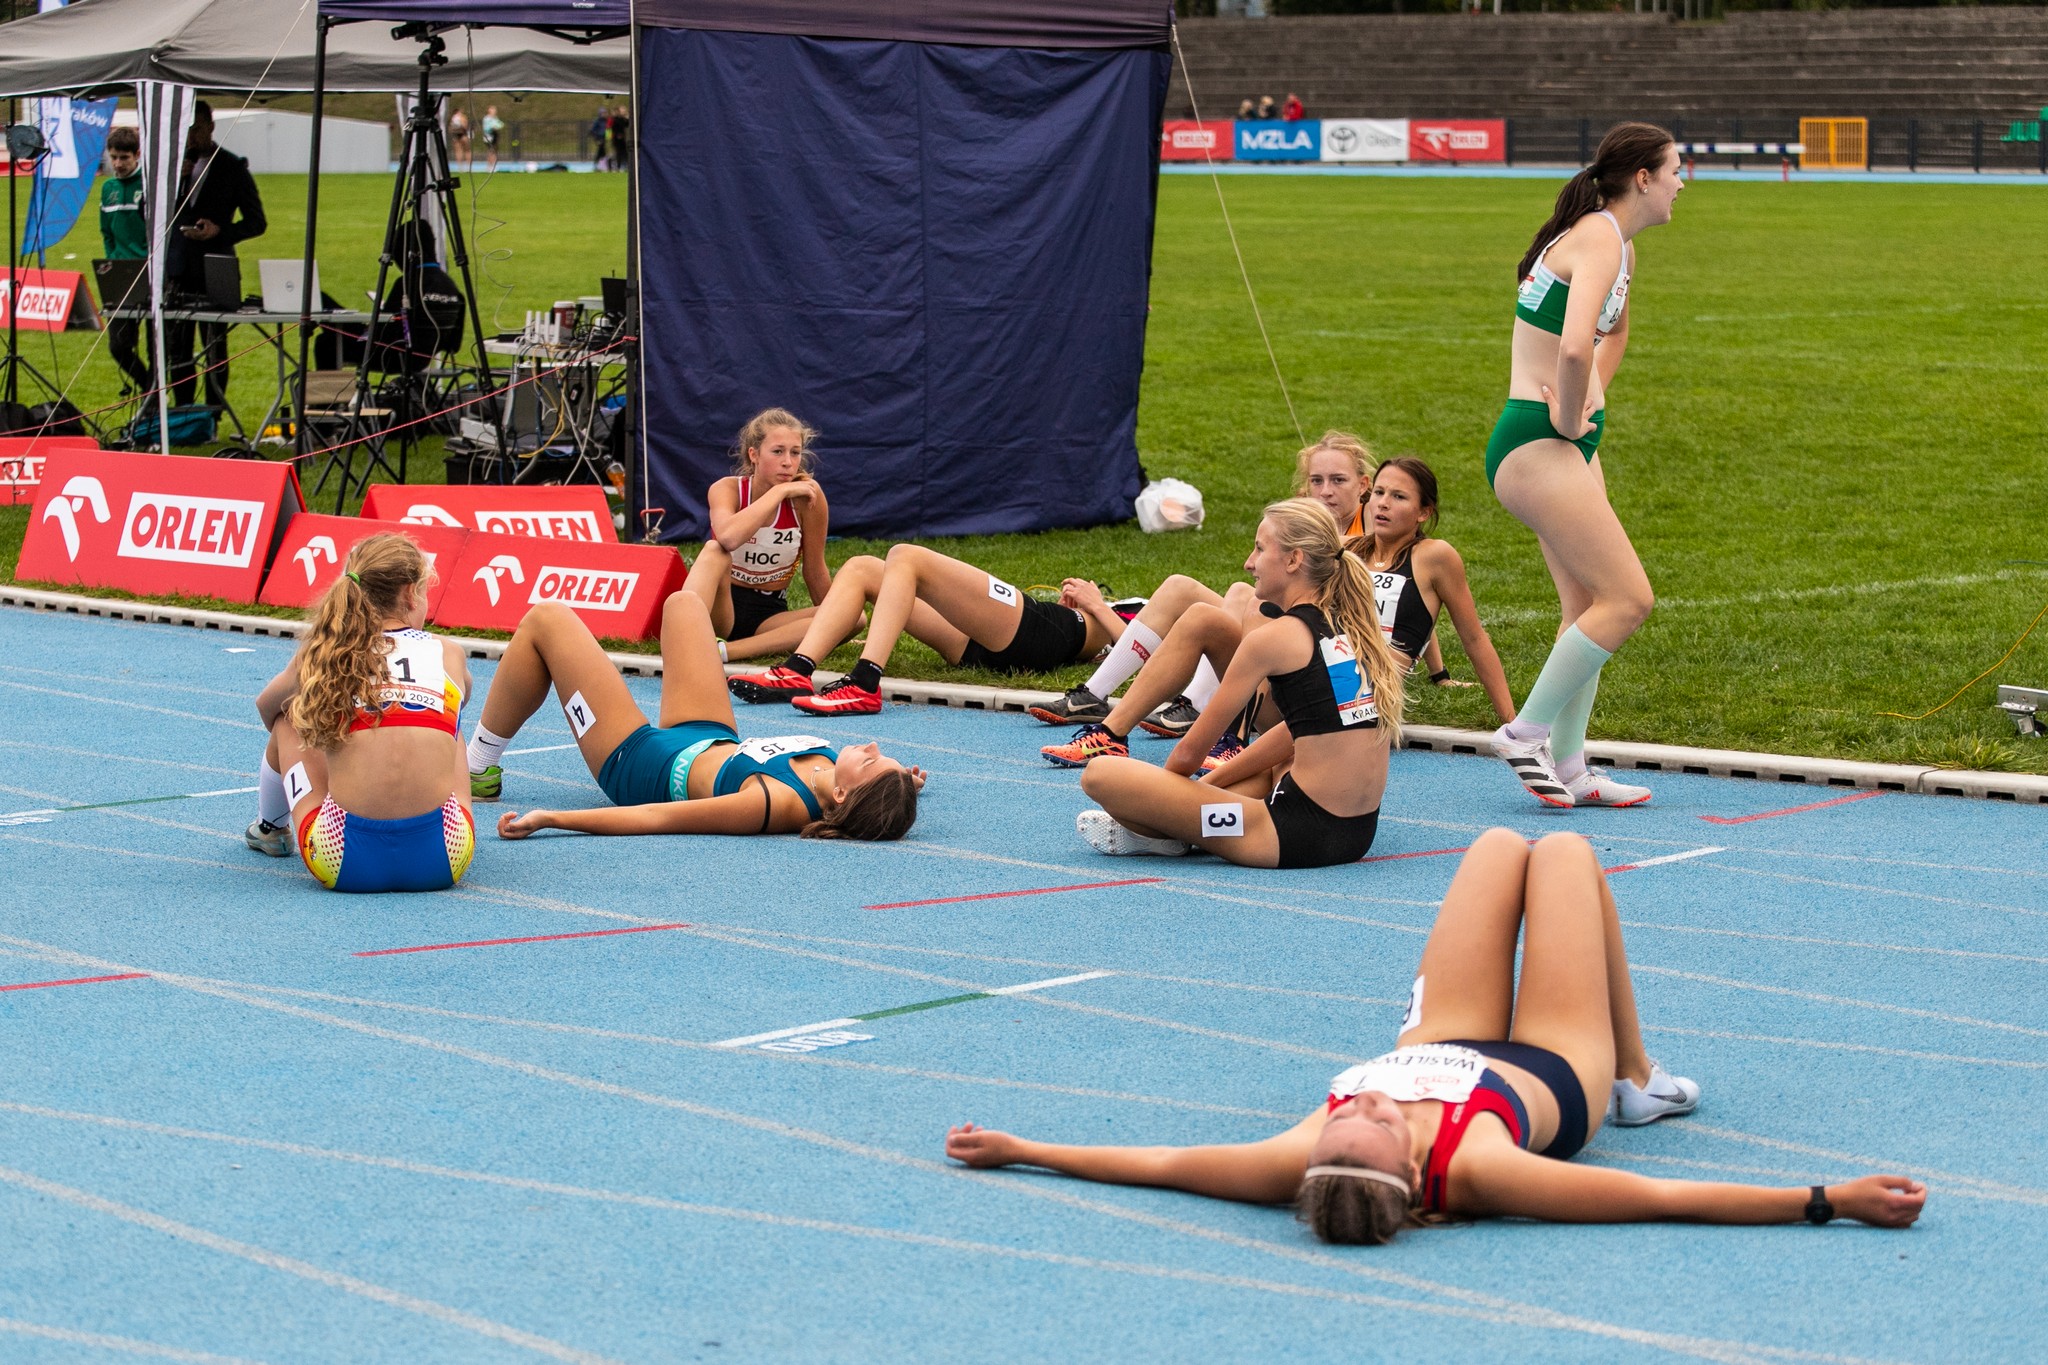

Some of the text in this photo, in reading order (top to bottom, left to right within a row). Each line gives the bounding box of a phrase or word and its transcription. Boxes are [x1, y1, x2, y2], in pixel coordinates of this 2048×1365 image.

[1242, 129, 1313, 149] MZLA
[21, 292, 65, 315] ORLEN
[1, 464, 44, 480] RLE
[131, 502, 252, 556] ORLEN
[486, 517, 594, 543] ORLEN
[773, 530, 793, 545] 24
[744, 551, 781, 565] HOC
[731, 570, 767, 583] KRAKÓW
[1374, 574, 1394, 589] 28
[538, 572, 631, 605] ORLEN
[389, 657, 417, 684] 1
[409, 692, 436, 707] 2022
[572, 705, 586, 727] 4
[760, 742, 786, 756] 15
[290, 772, 303, 799] 7
[673, 757, 689, 801] NIKE
[1208, 812, 1237, 828] 3
[1380, 1054, 1475, 1072] WASILEW
